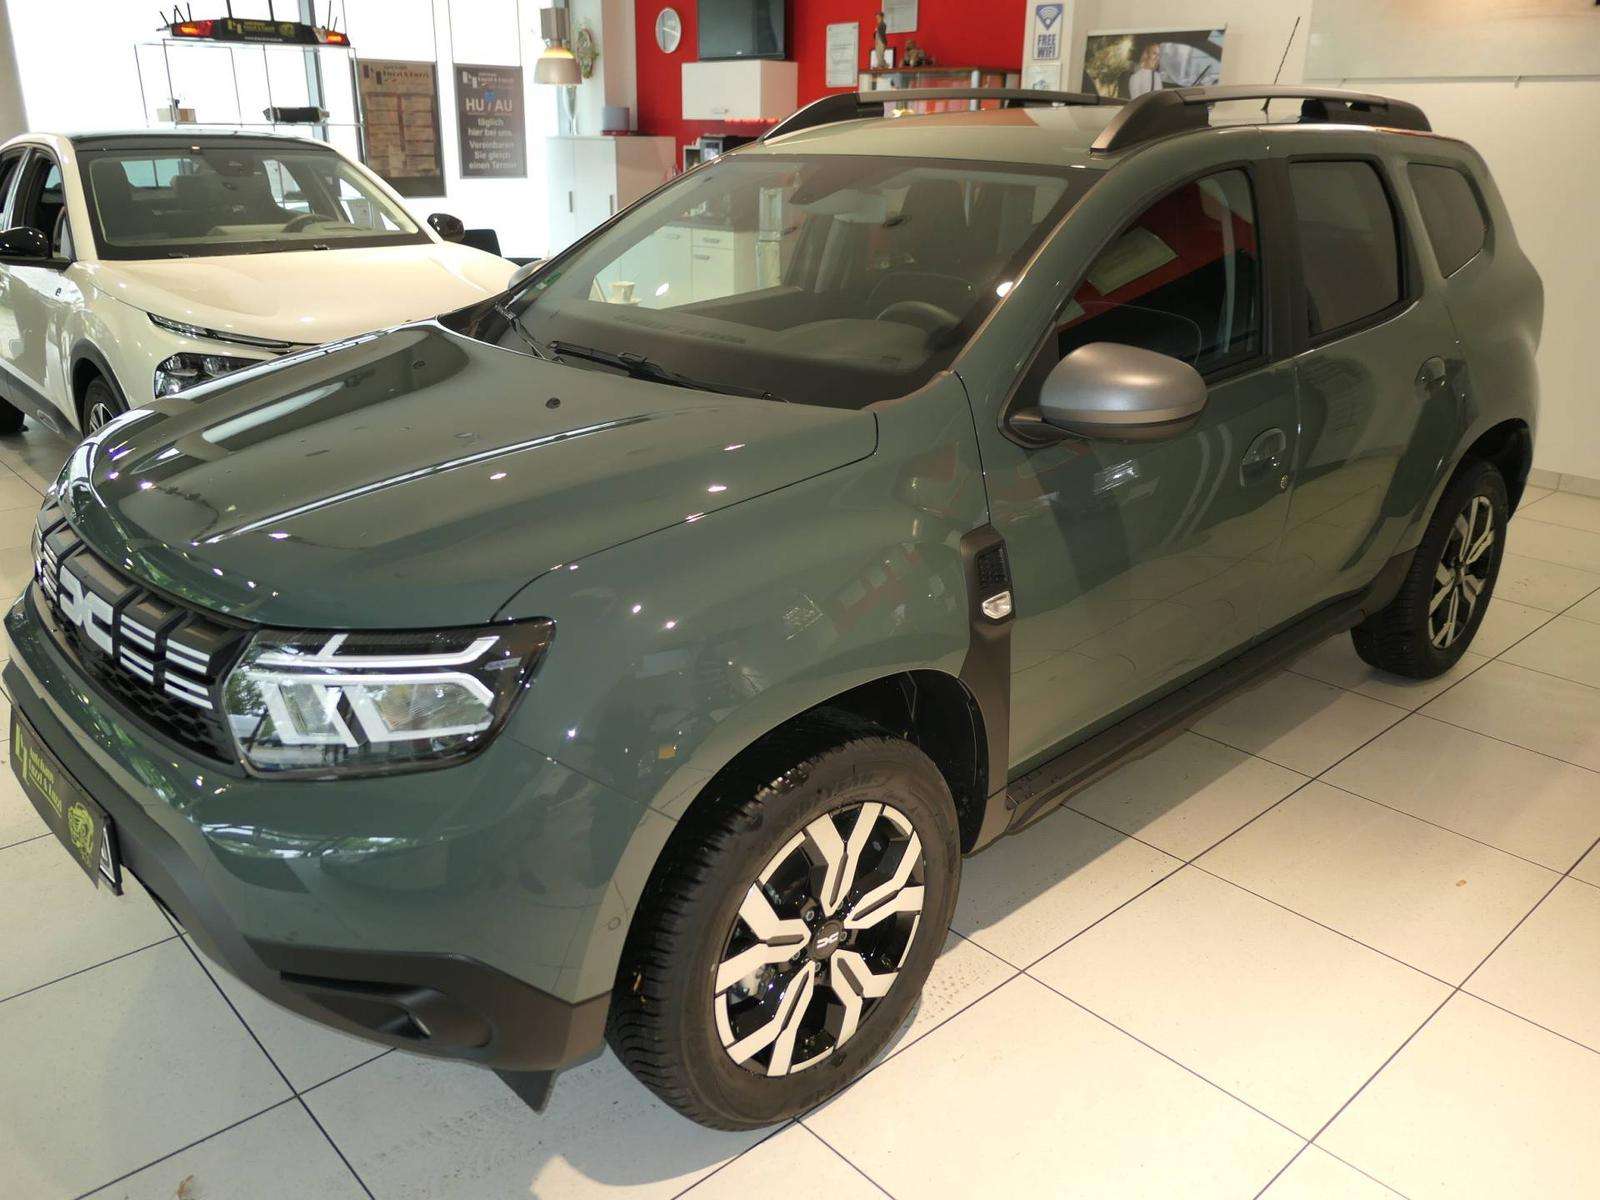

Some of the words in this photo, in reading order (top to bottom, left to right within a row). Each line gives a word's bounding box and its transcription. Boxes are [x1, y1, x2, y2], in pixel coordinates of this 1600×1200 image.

[1037, 34, 1056, 46] FREE
[1037, 47, 1056, 57] WIFI
[465, 97, 485, 112] HU
[494, 98, 513, 113] AU
